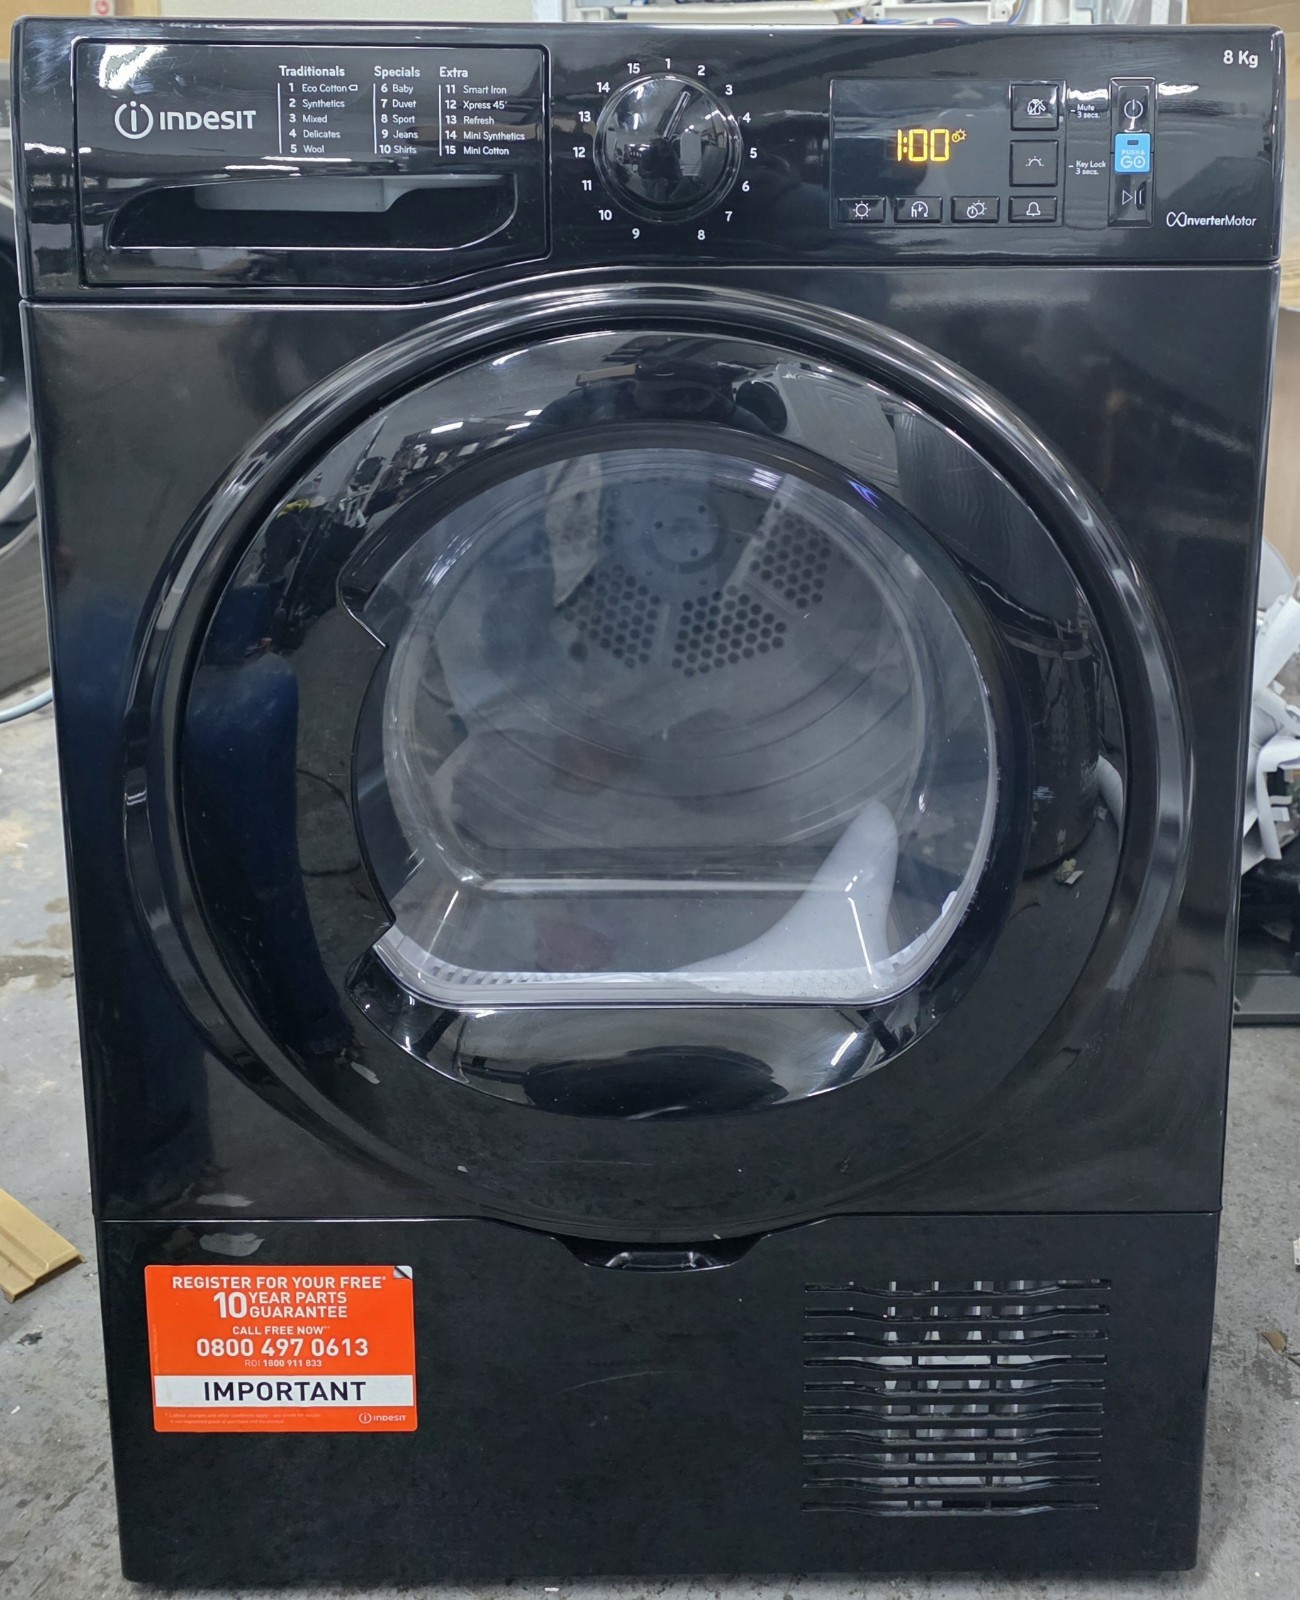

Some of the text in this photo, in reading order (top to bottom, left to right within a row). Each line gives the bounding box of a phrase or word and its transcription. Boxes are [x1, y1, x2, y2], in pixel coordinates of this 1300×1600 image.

[665, 58, 671, 69] 1
[1223, 50, 1259, 68] 8 Kg
[279, 65, 345, 76] Traditionals
[374, 66, 420, 79] Specials
[440, 66, 468, 78] Extra
[627, 63, 641, 74] 15
[697, 65, 706, 76] 2
[289, 82, 347, 92] 1 Eco Cotton
[381, 83, 414, 94] 6 Baby
[445, 84, 507, 94] 11 Smart Iron
[597, 82, 611, 93] 14
[725, 84, 733, 95] 3
[289, 98, 345, 109] 2 Synthetics
[381, 98, 417, 108] 7 Duvet
[445, 100, 457, 109] 12
[463, 100, 491, 111] Xpress
[289, 114, 328, 123] 3 Mixed
[380, 114, 415, 124] 8 Sport
[445, 115, 494, 125] 13 Refresh
[578, 111, 591, 122] 13
[742, 112, 752, 123] 4
[1077, 111, 1083, 119] 3
[289, 128, 341, 138] 4 Delicates
[381, 129, 418, 139] 9 Jeans
[445, 130, 525, 142] 14 Mini Synthetics
[290, 144, 324, 153] 5 Wool
[379, 144, 417, 154] 10 Shirts
[445, 145, 509, 155] 15 Mini Cotton
[897, 129, 950, 162] 1:00
[573, 147, 586, 158] 12
[750, 148, 758, 159] 5
[1076, 160, 1107, 170] Key Lock
[1120, 156, 1146, 168] GO
[582, 180, 592, 191] 11
[742, 181, 750, 192] 6
[599, 210, 612, 221] 10
[725, 211, 733, 222] 7
[632, 228, 640, 239] 9
[697, 229, 706, 240] 8
[172, 1276, 251, 1289] REGISTER
[257, 1276, 288, 1289] FOR
[292, 1276, 335, 1289] YOUR
[213, 1292, 347, 1318] 10 YEAR PARTS
[250, 1306, 348, 1318] GUARANTEE
[232, 1326, 262, 1335] CALL
[265, 1326, 295, 1335] FREE
[196, 1338, 368, 1357] 0800 497 0613
[204, 1381, 367, 1401] IMPORTANT
